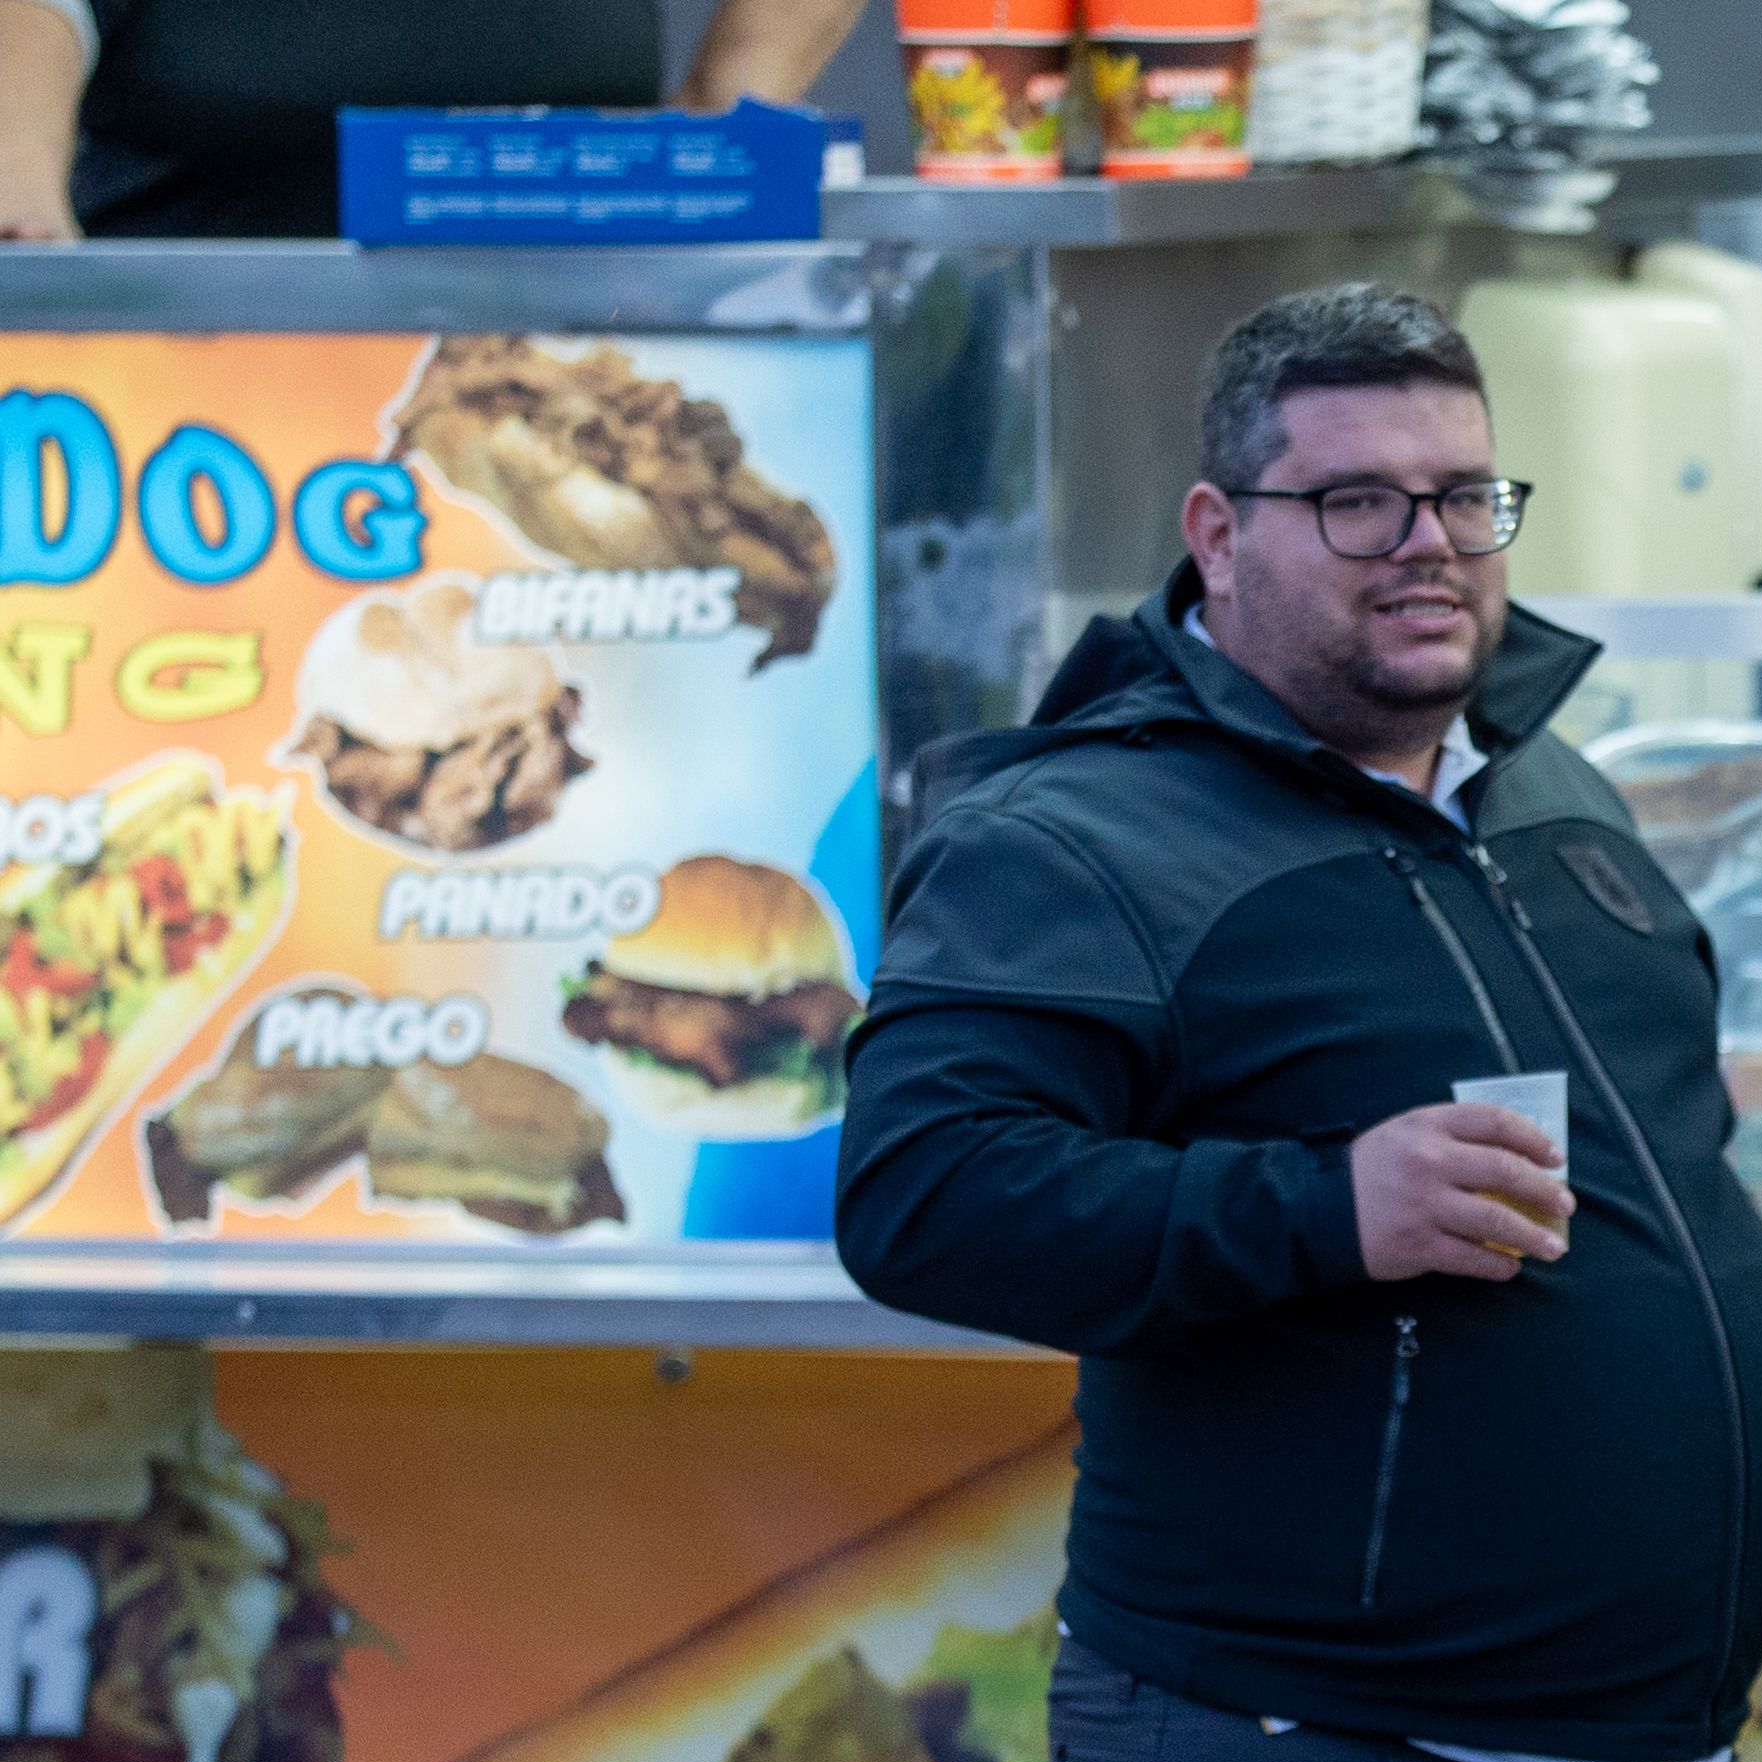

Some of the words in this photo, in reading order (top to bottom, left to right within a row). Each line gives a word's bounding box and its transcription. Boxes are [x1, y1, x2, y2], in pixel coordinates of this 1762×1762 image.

[478, 567, 741, 640] BIFANAS
[378, 867, 662, 942] PANADO
[254, 997, 487, 1069] PREGO
